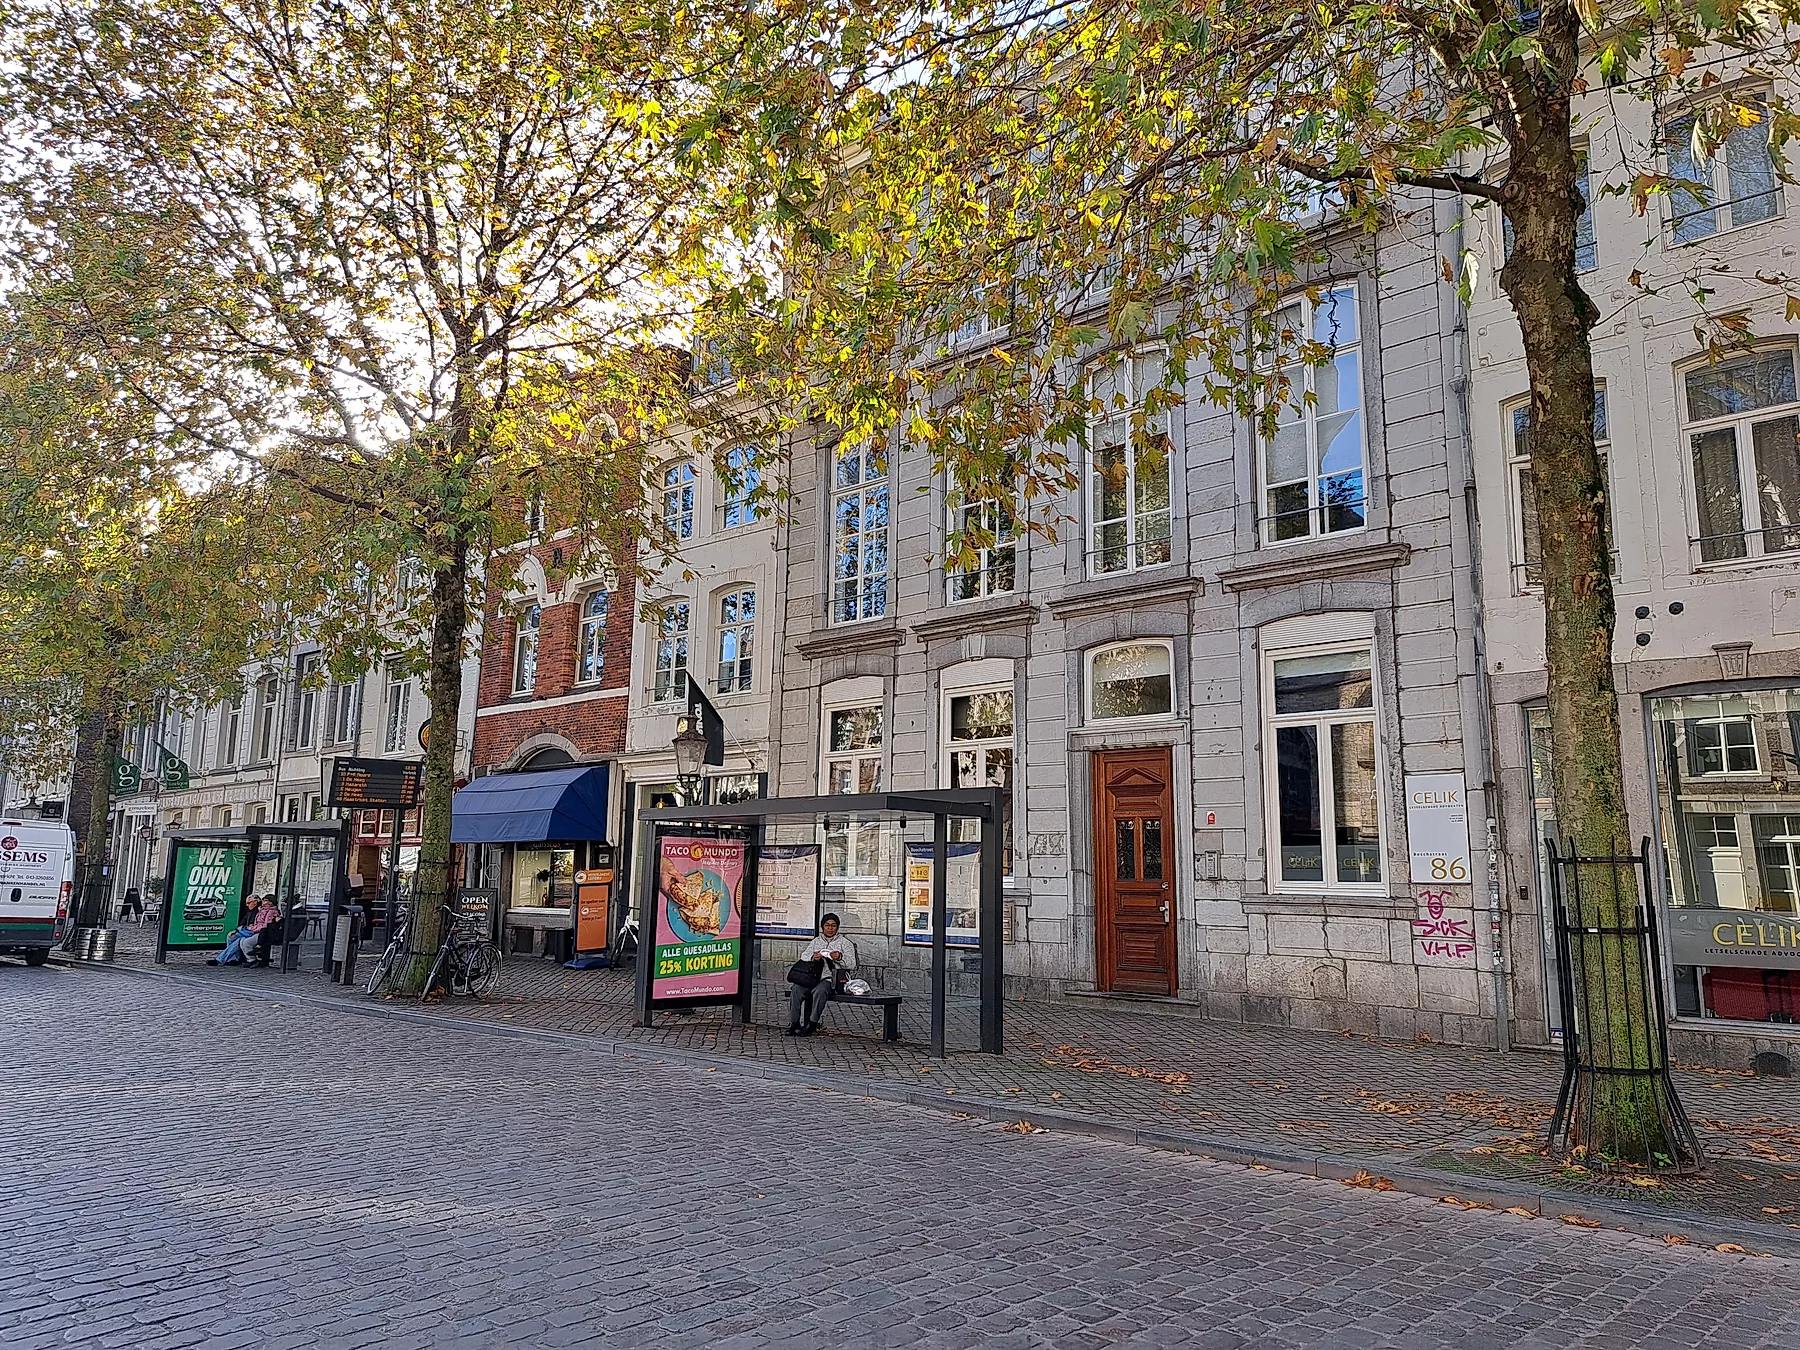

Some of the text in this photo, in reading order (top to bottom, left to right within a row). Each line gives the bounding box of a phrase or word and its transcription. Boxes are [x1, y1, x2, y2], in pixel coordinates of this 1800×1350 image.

[1413, 790, 1458, 804] CELIK
[0, 850, 48, 863] SEMS
[198, 848, 228, 866] WE
[666, 846, 738, 856] TACO MUNDO
[1431, 856, 1466, 880] 86
[188, 866, 232, 886] OWN
[462, 896, 490, 904] OPEN
[662, 942, 732, 958] ALLE QUESADILLAS
[660, 954, 733, 975] 25% KORTING
[666, 986, 724, 995] www.TacoMundo.com
